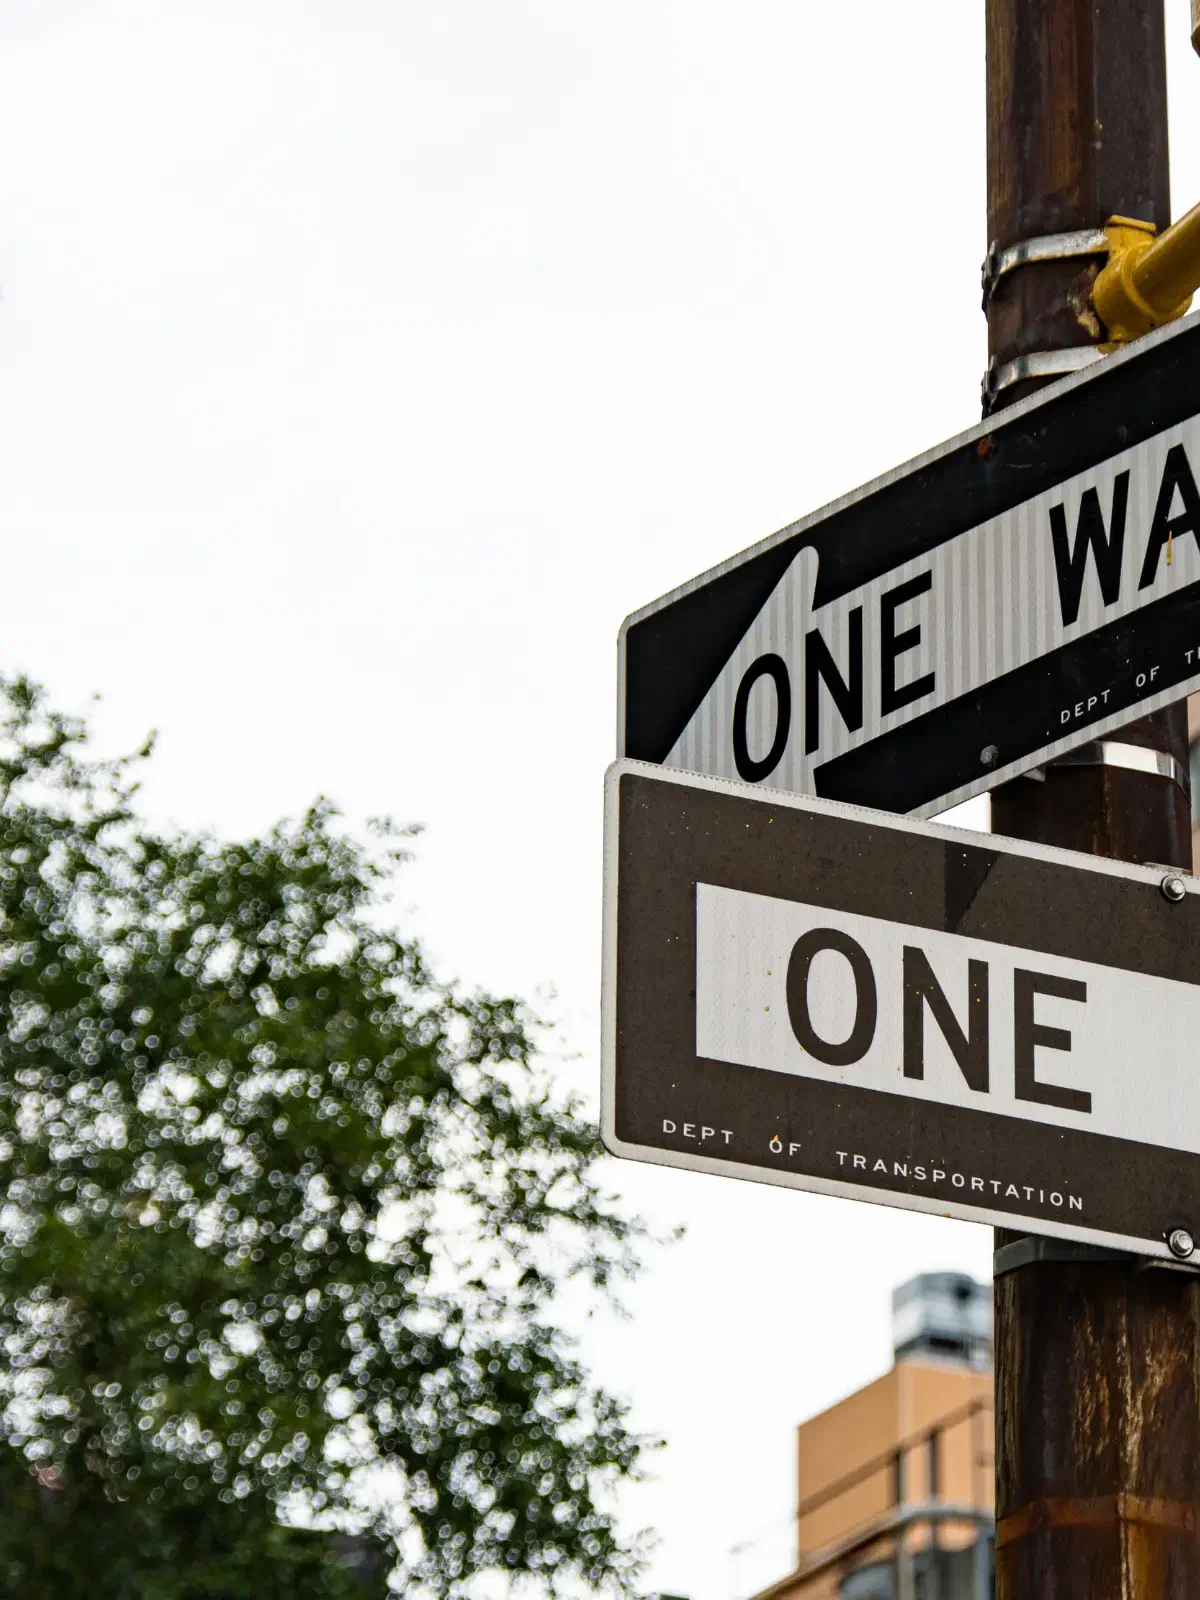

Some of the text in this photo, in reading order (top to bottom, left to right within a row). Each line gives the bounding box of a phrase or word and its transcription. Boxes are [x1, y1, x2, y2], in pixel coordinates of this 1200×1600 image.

[733, 570, 935, 784] ONE
[1060, 689, 1111, 724] DEPT
[1135, 666, 1160, 688] OF
[786, 927, 1092, 1114] ONE
[662, 1119, 1084, 1211] DEPT OF TRANSPORTATION
